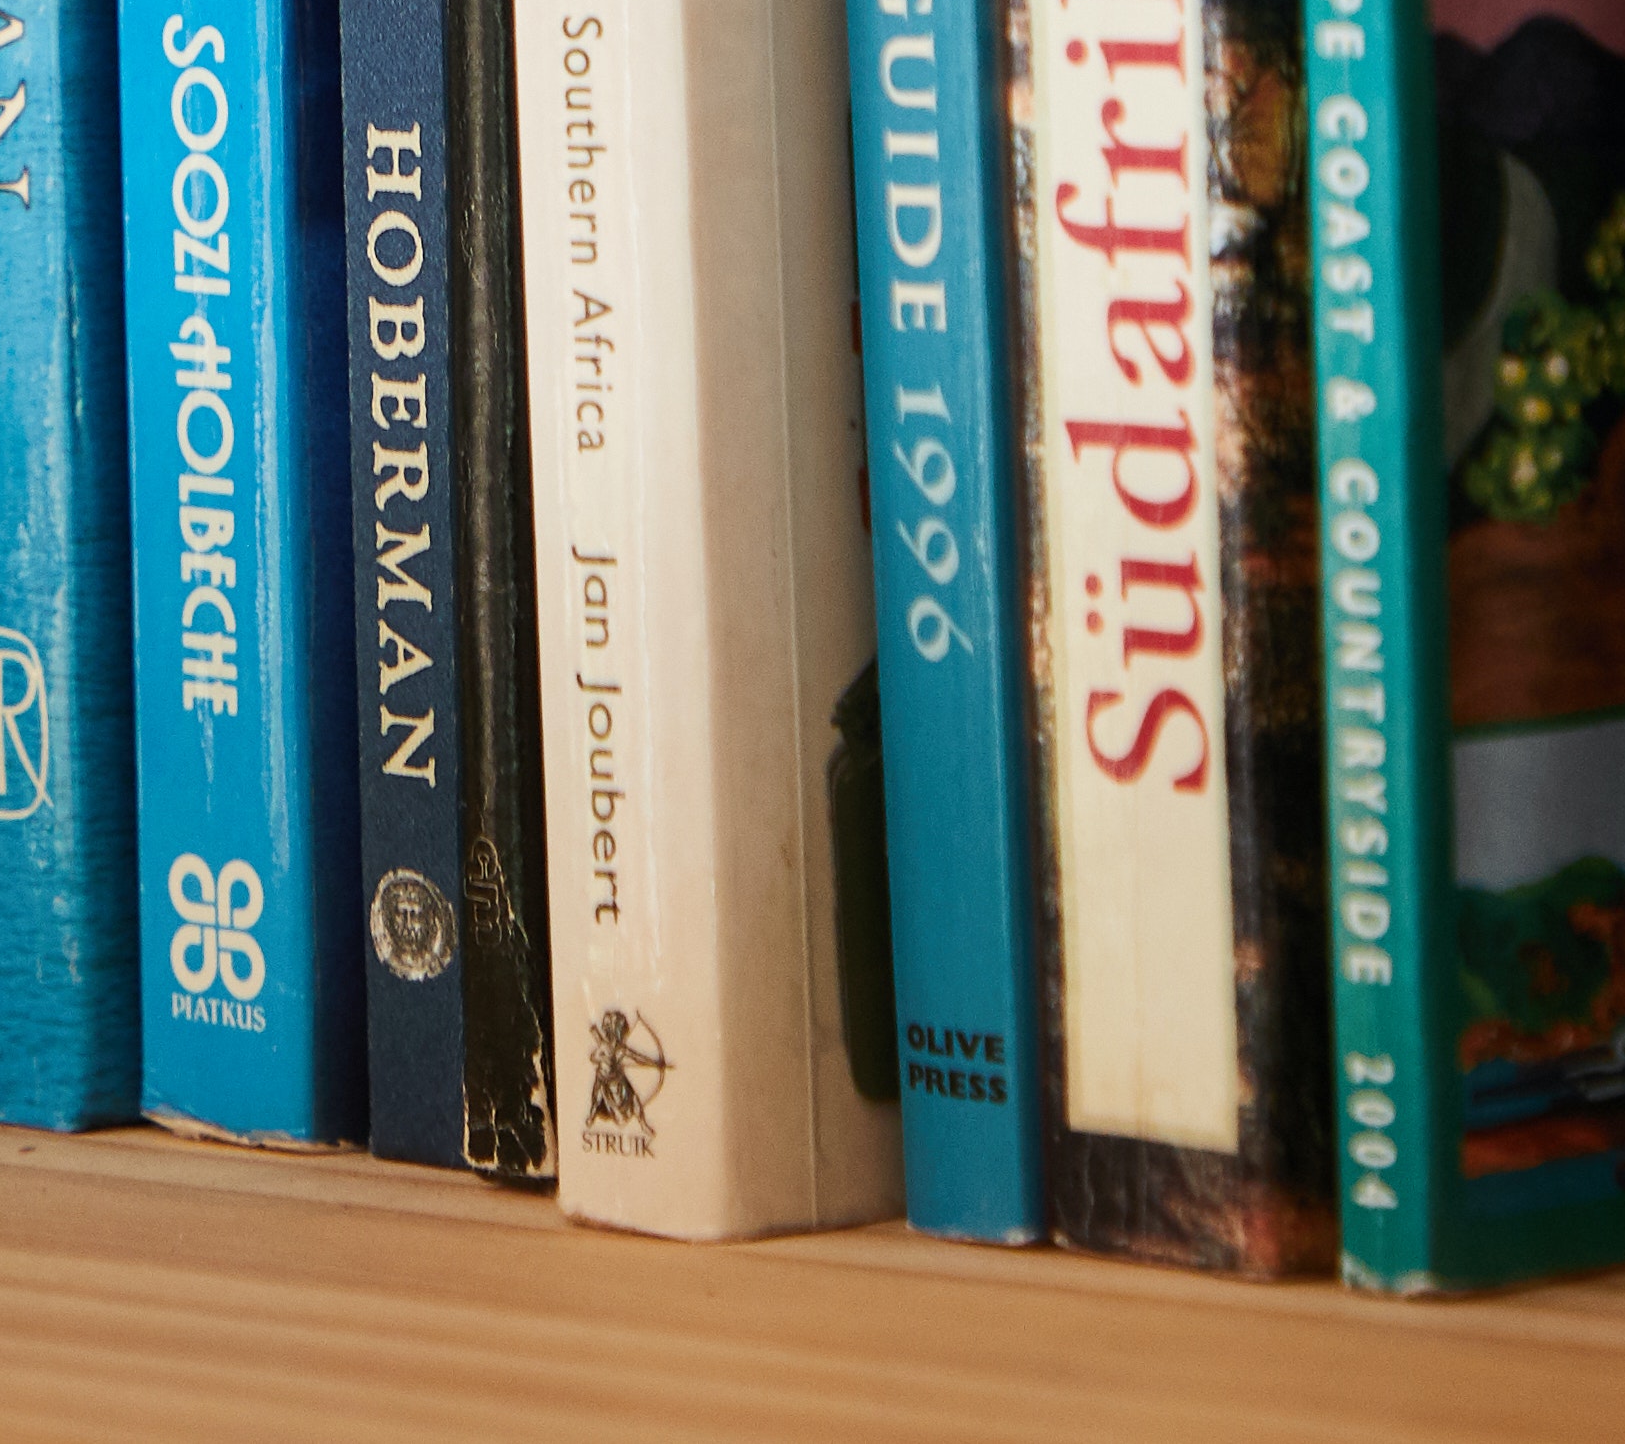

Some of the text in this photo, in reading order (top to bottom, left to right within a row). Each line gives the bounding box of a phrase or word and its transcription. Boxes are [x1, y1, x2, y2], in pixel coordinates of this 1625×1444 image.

[162, 14, 230, 296] SOOZI
[561, 15, 611, 268] Southern
[1316, 95, 1373, 346] COAST
[365, 121, 438, 787] HOBERMAN
[570, 293, 616, 456] Africa
[1327, 377, 1375, 421] &
[167, 315, 237, 717] HOLBECHE
[896, 389, 971, 662] 1996
[572, 546, 623, 928] Jan Joubert
[1329, 457, 1392, 986] COUNTRYSIDE
[172, 992, 265, 1031] PIATKUS
[905, 1022, 1005, 1065] OLIVE
[905, 1062, 1008, 1104] PRESS
[1346, 1052, 1397, 1209] 2004
[582, 1131, 658, 1161] STRUIK
